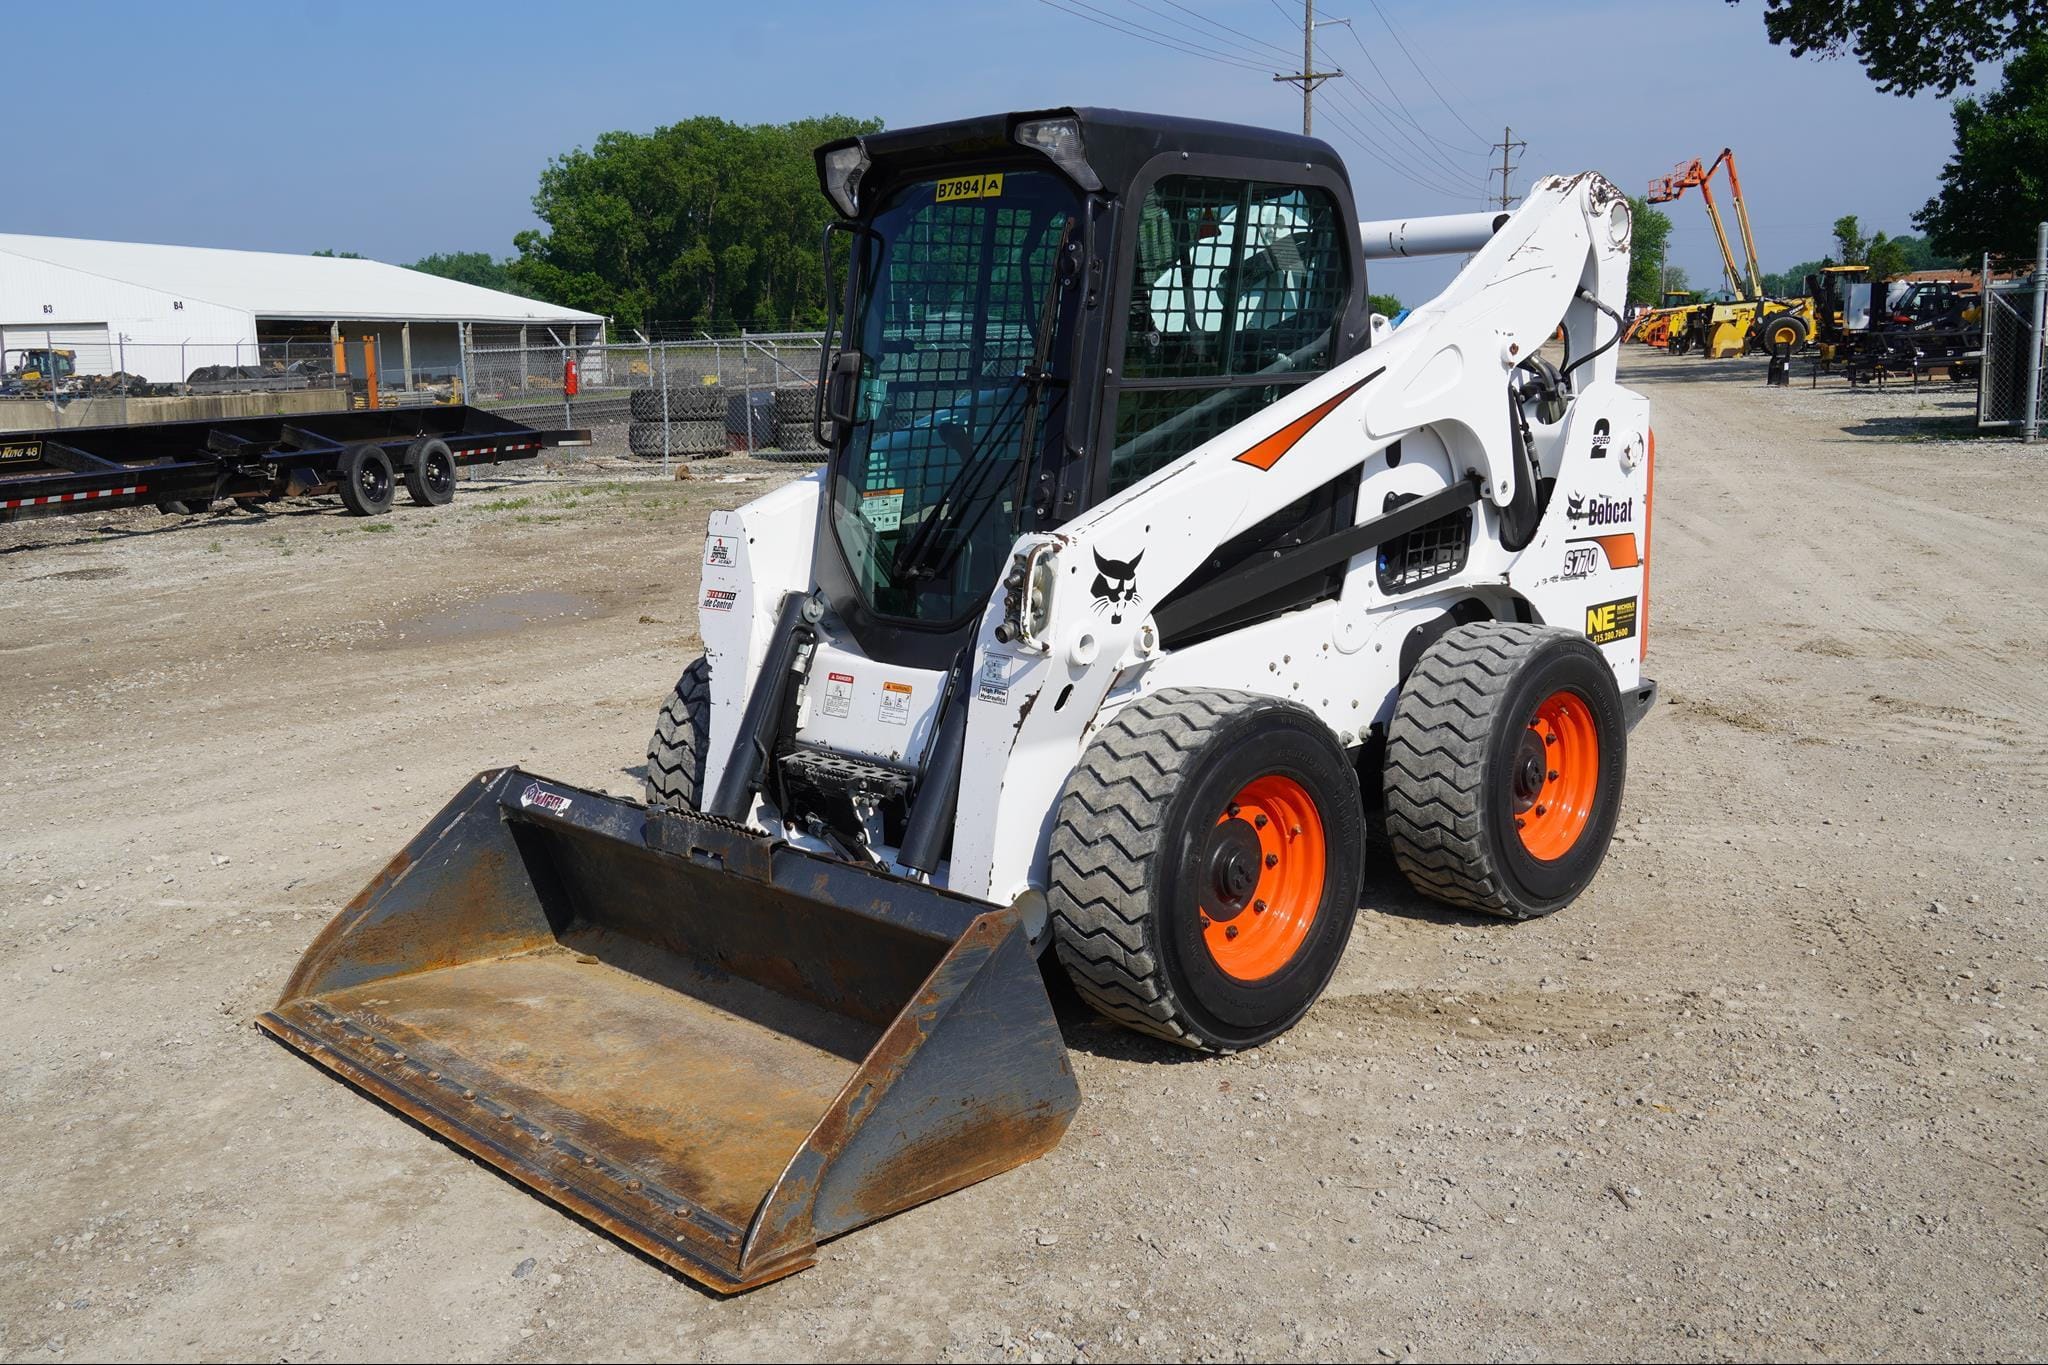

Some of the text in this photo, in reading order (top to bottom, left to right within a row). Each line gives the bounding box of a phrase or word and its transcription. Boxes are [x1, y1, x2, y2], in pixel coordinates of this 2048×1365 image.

[938, 179, 999, 198] B7894 A
[43, 304, 53, 314] B3
[173, 301, 184, 310] B4
[1914, 321, 1933, 331] DEERE
[1590, 418, 1610, 459] 2
[1592, 436, 1610, 445] SPEED
[25, 446, 38, 457] 48
[1588, 497, 1632, 526] Bobcat
[1563, 547, 1598, 576] S770
[1587, 605, 1616, 635] NE
